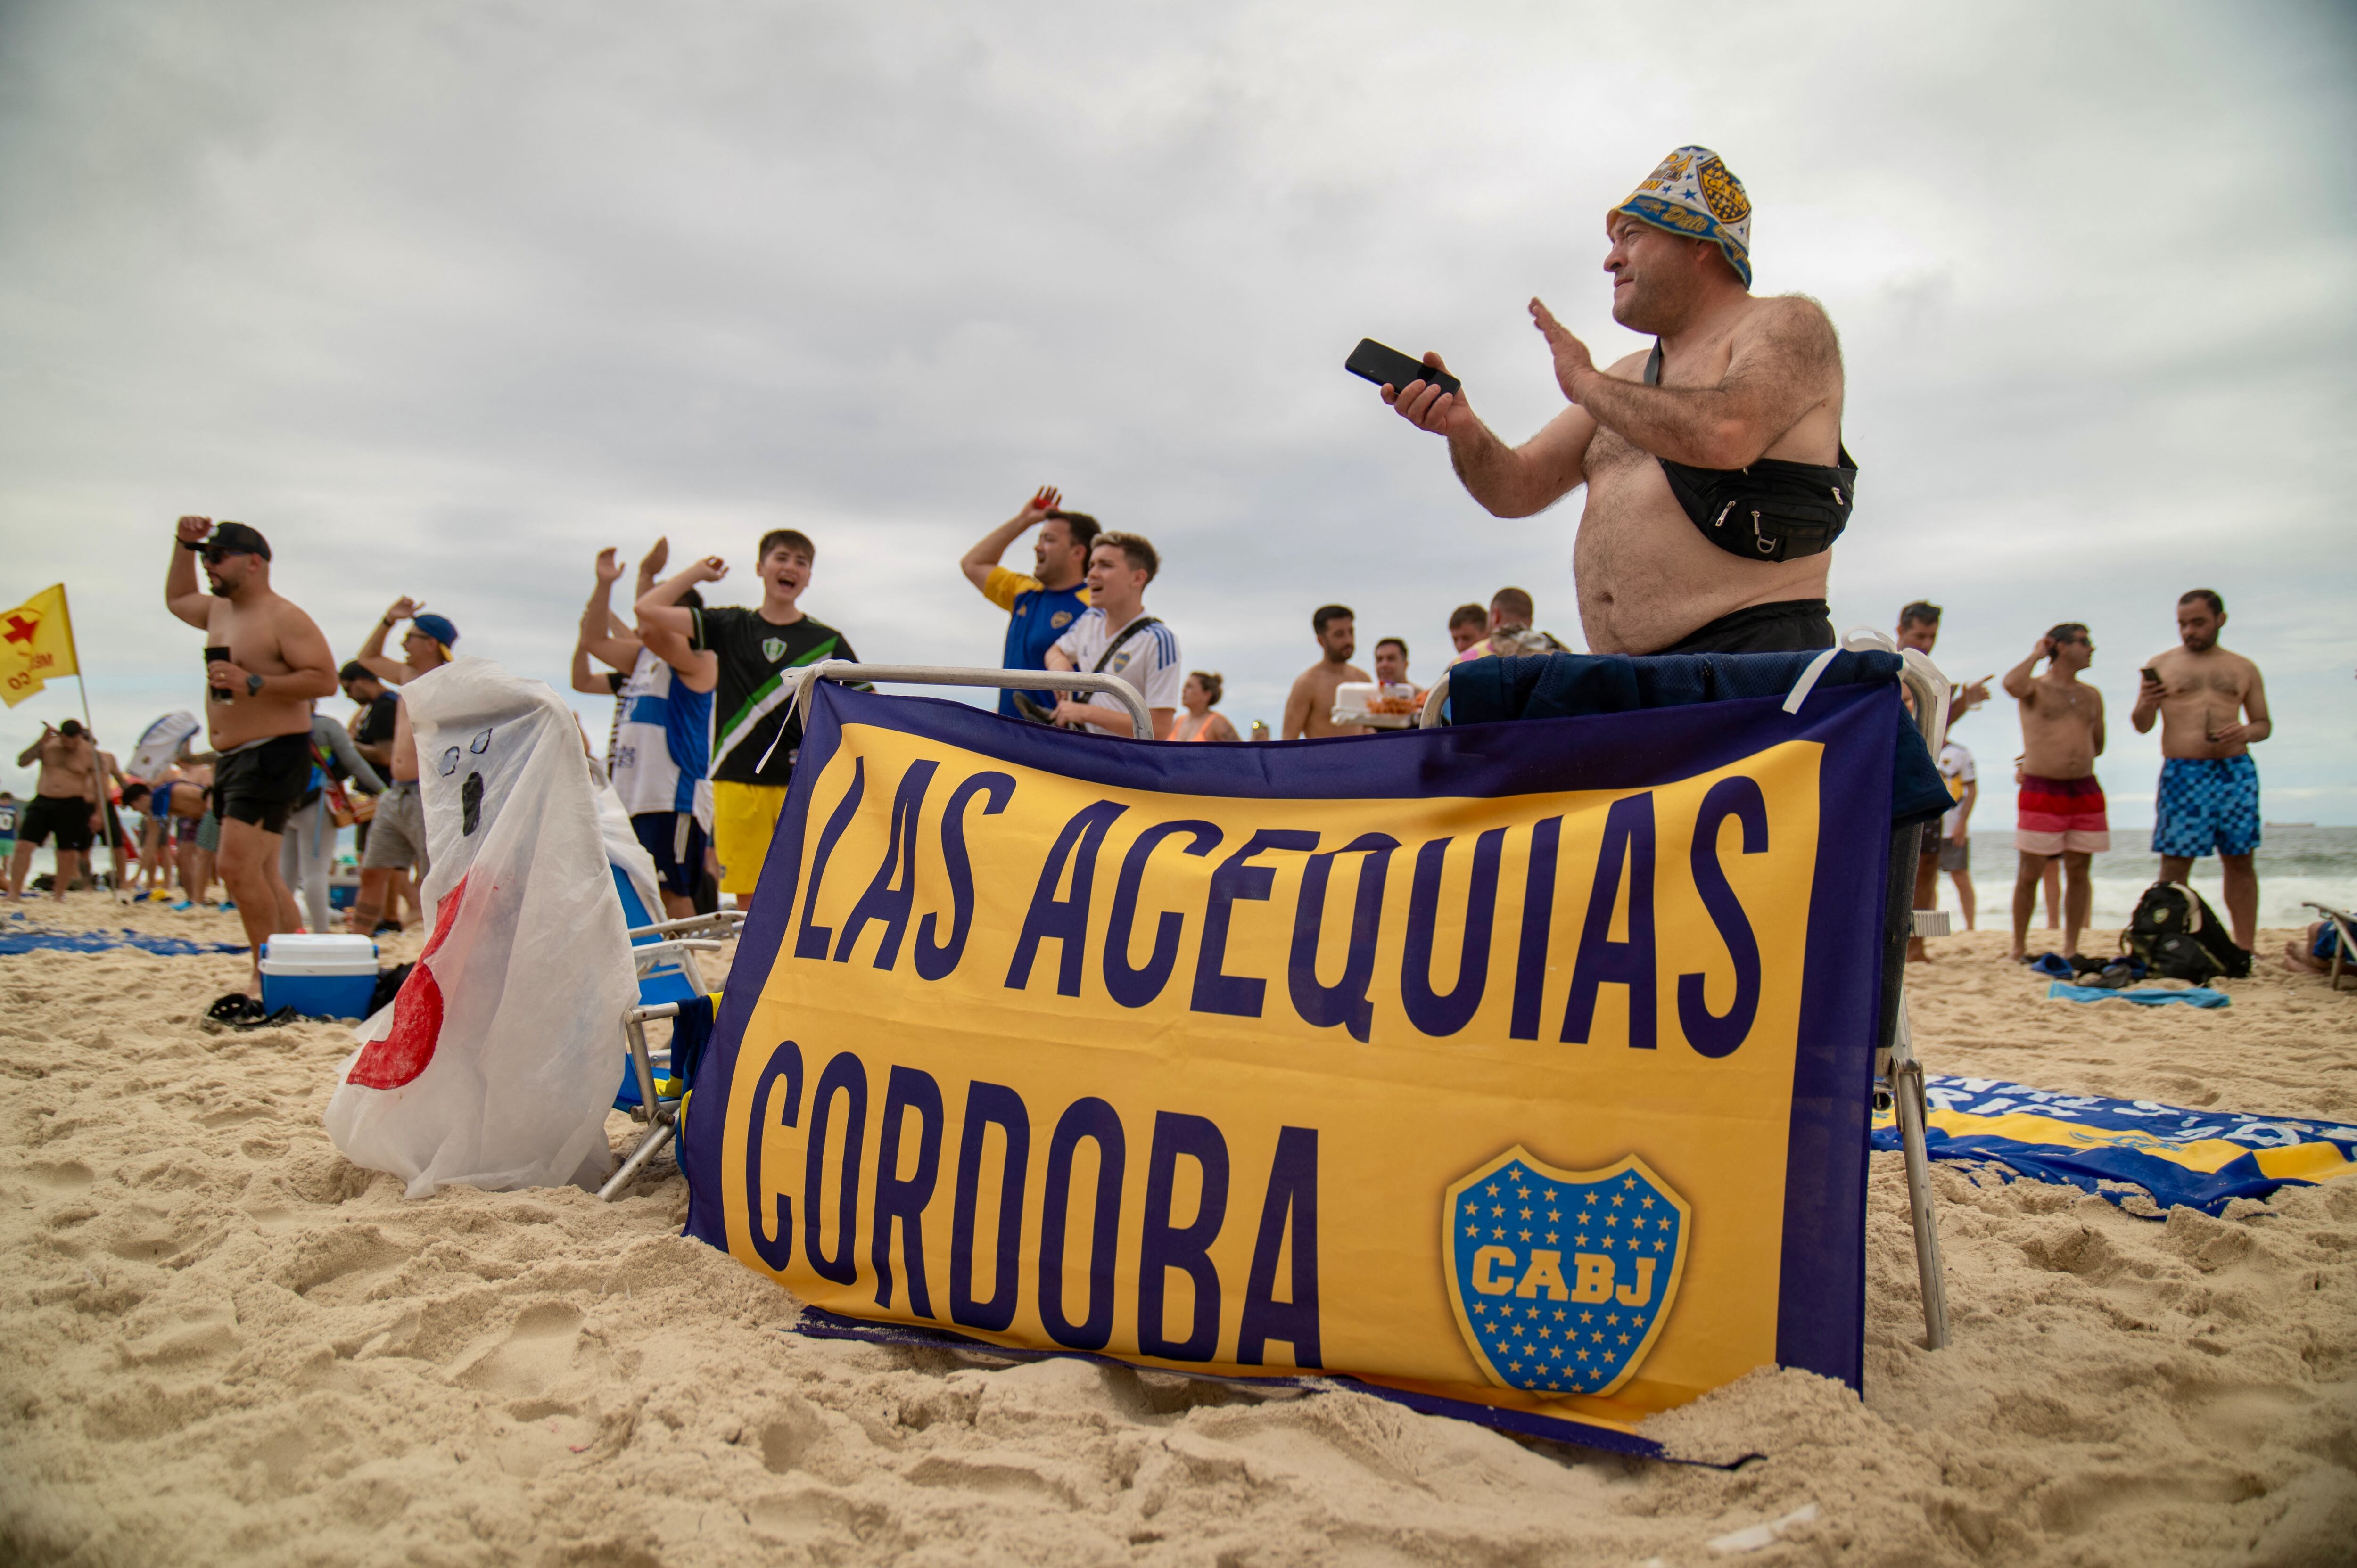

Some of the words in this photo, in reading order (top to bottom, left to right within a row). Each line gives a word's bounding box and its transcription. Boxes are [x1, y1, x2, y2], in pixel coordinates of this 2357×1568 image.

[1661, 205, 1709, 233] Dale
[794, 755, 1017, 981] LAS
[1005, 776, 1768, 1058] ACEQUIAS
[746, 1041, 1323, 1369] CORDOBA
[1472, 1244, 1657, 1307] CABJ
